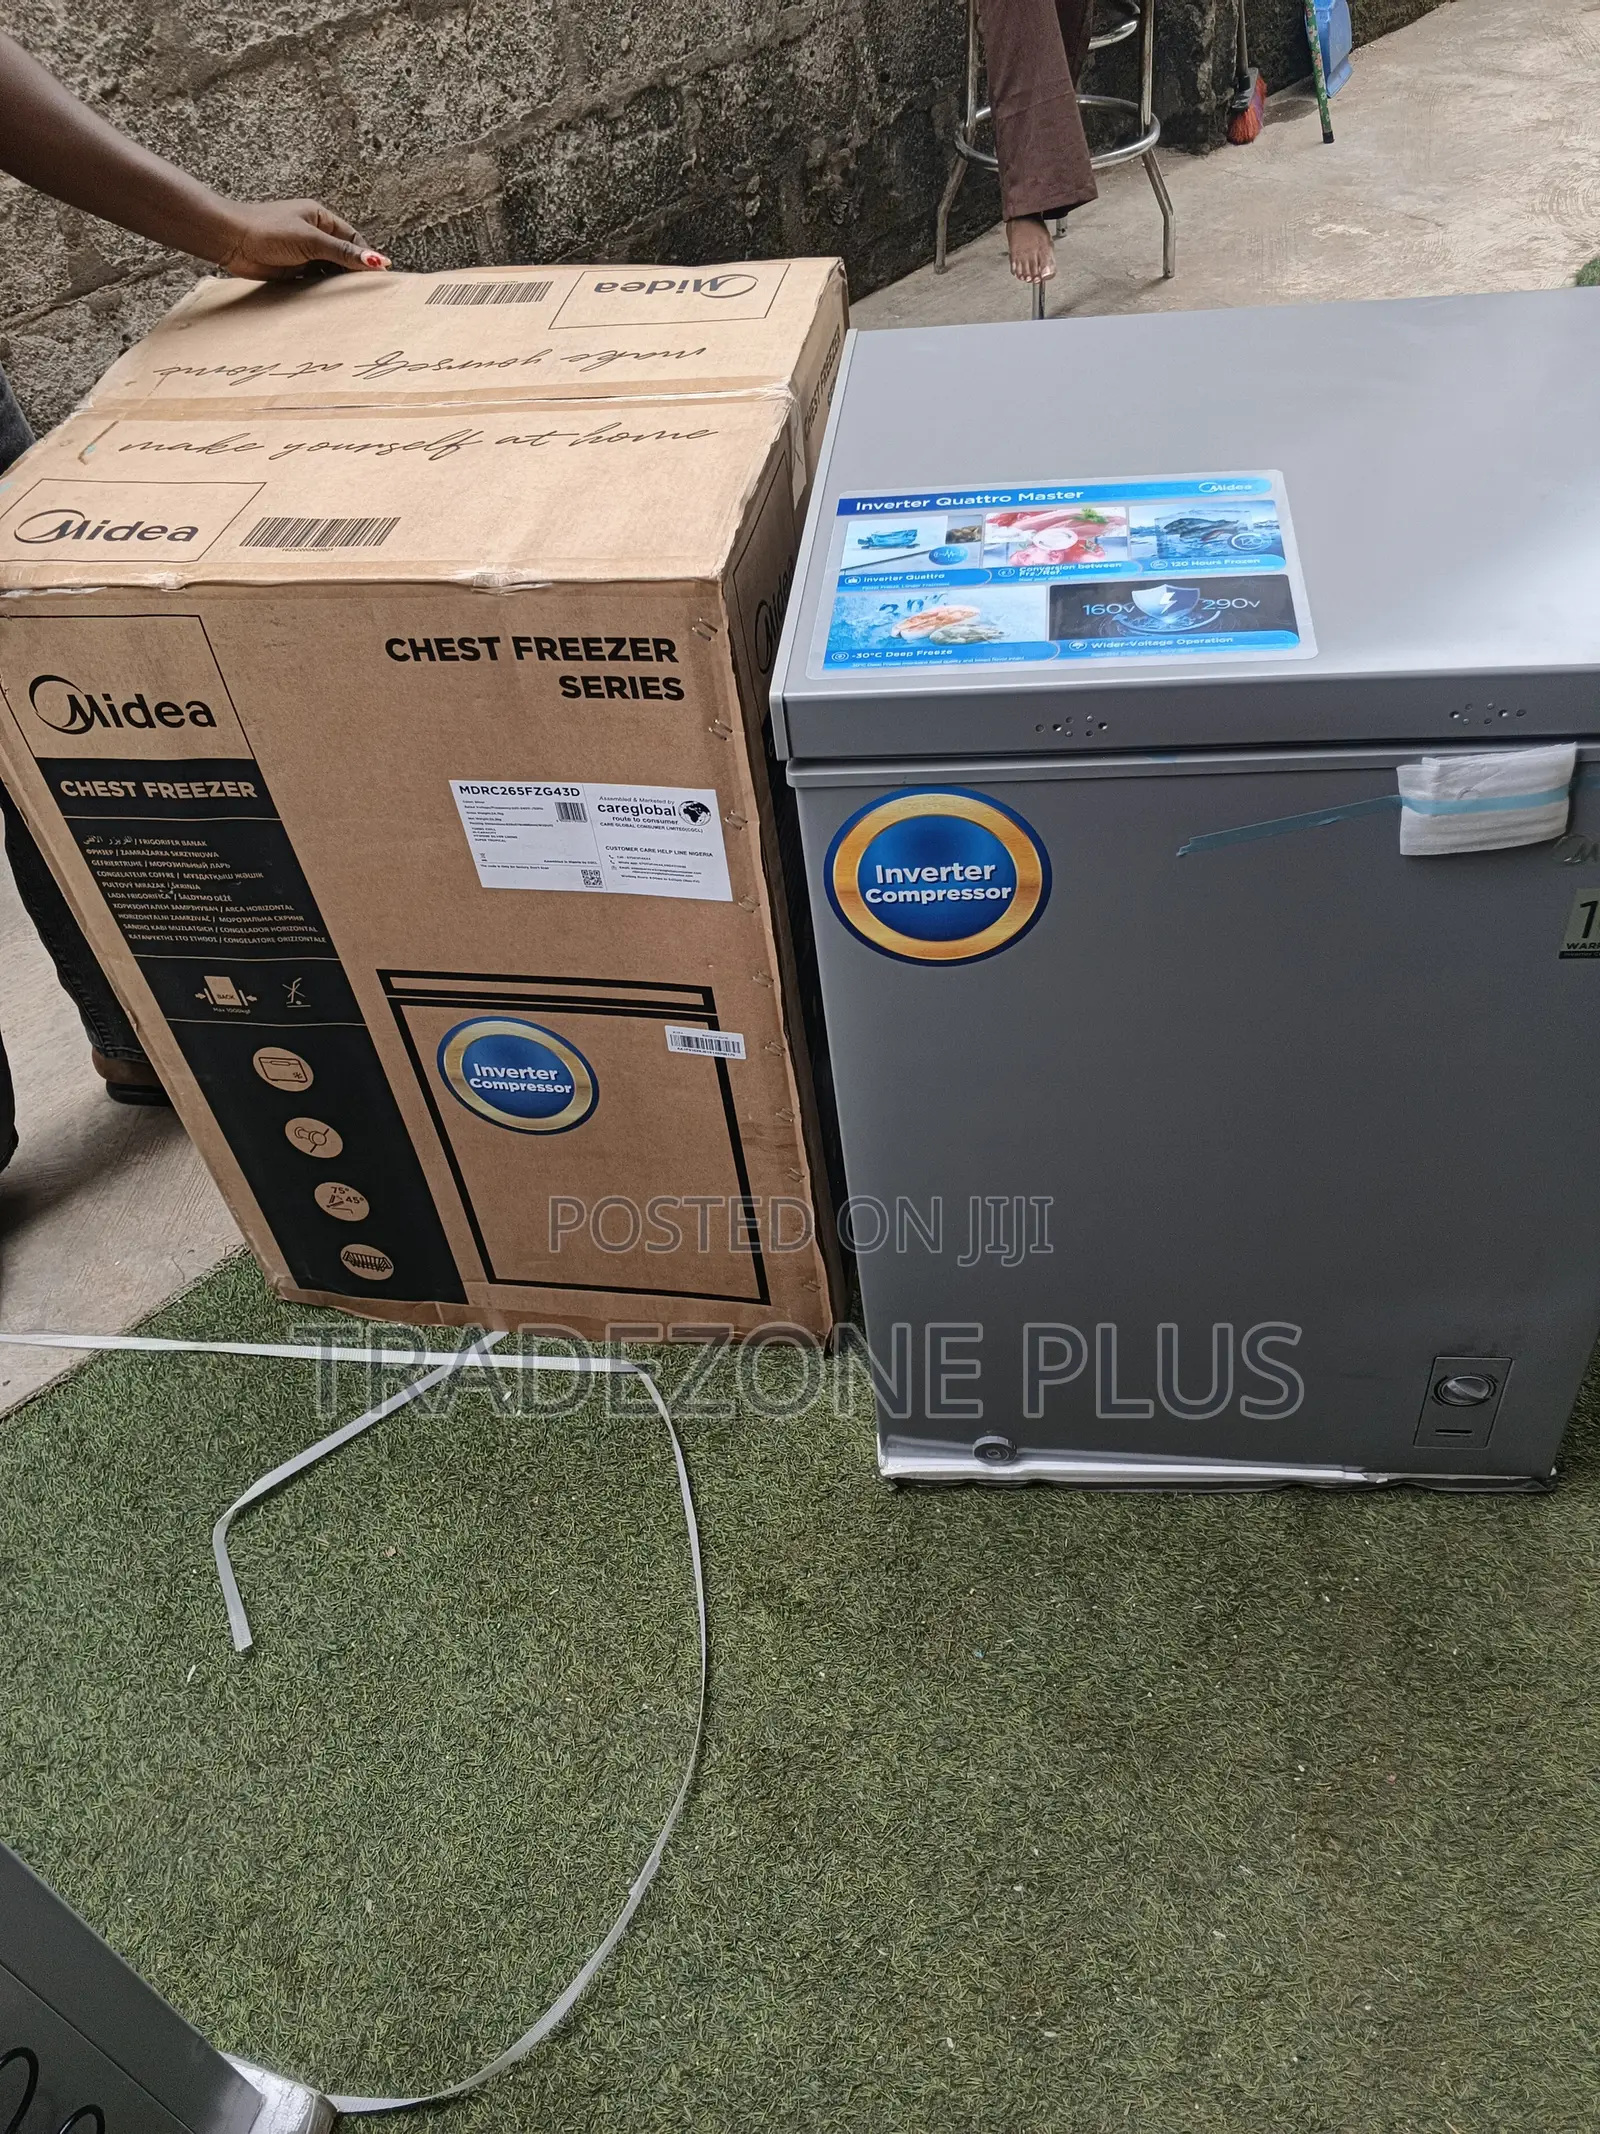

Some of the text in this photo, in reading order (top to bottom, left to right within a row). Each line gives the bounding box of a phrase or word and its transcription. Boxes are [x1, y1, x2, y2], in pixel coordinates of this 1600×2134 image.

[594, 272, 759, 300] Midea
[153, 347, 707, 387] make yourself at home
[118, 421, 719, 461] make yourself at home
[1198, 481, 1253, 494] Midea
[855, 488, 1084, 512] Inverter Quattro Master
[13, 508, 200, 545] Midea
[1077, 562, 1123, 570] between
[1224, 558, 1260, 566] Frozen
[863, 573, 945, 583] Inverter Quattro
[385, 634, 679, 663] CHEST FREEZER
[1091, 636, 1234, 649] Wider-Voltage Operation
[885, 651, 914, 659] Deep
[916, 649, 953, 657] Freeze
[558, 675, 685, 701] SERIES
[29, 674, 217, 735] Midea
[60, 780, 258, 799] CHEST FREEZER
[459, 785, 581, 797] MDRC265FZG43D
[597, 803, 677, 817] careglobal
[605, 845, 639, 853] CUSTOMER
[639, 846, 657, 854] CARE
[673, 849, 688, 857] LINE
[688, 850, 714, 858] NIGERIA
[874, 862, 997, 885] Inverter
[865, 885, 1012, 905] Compressor
[473, 1062, 559, 1082] Inverter
[469, 1077, 572, 1095] Compressor
